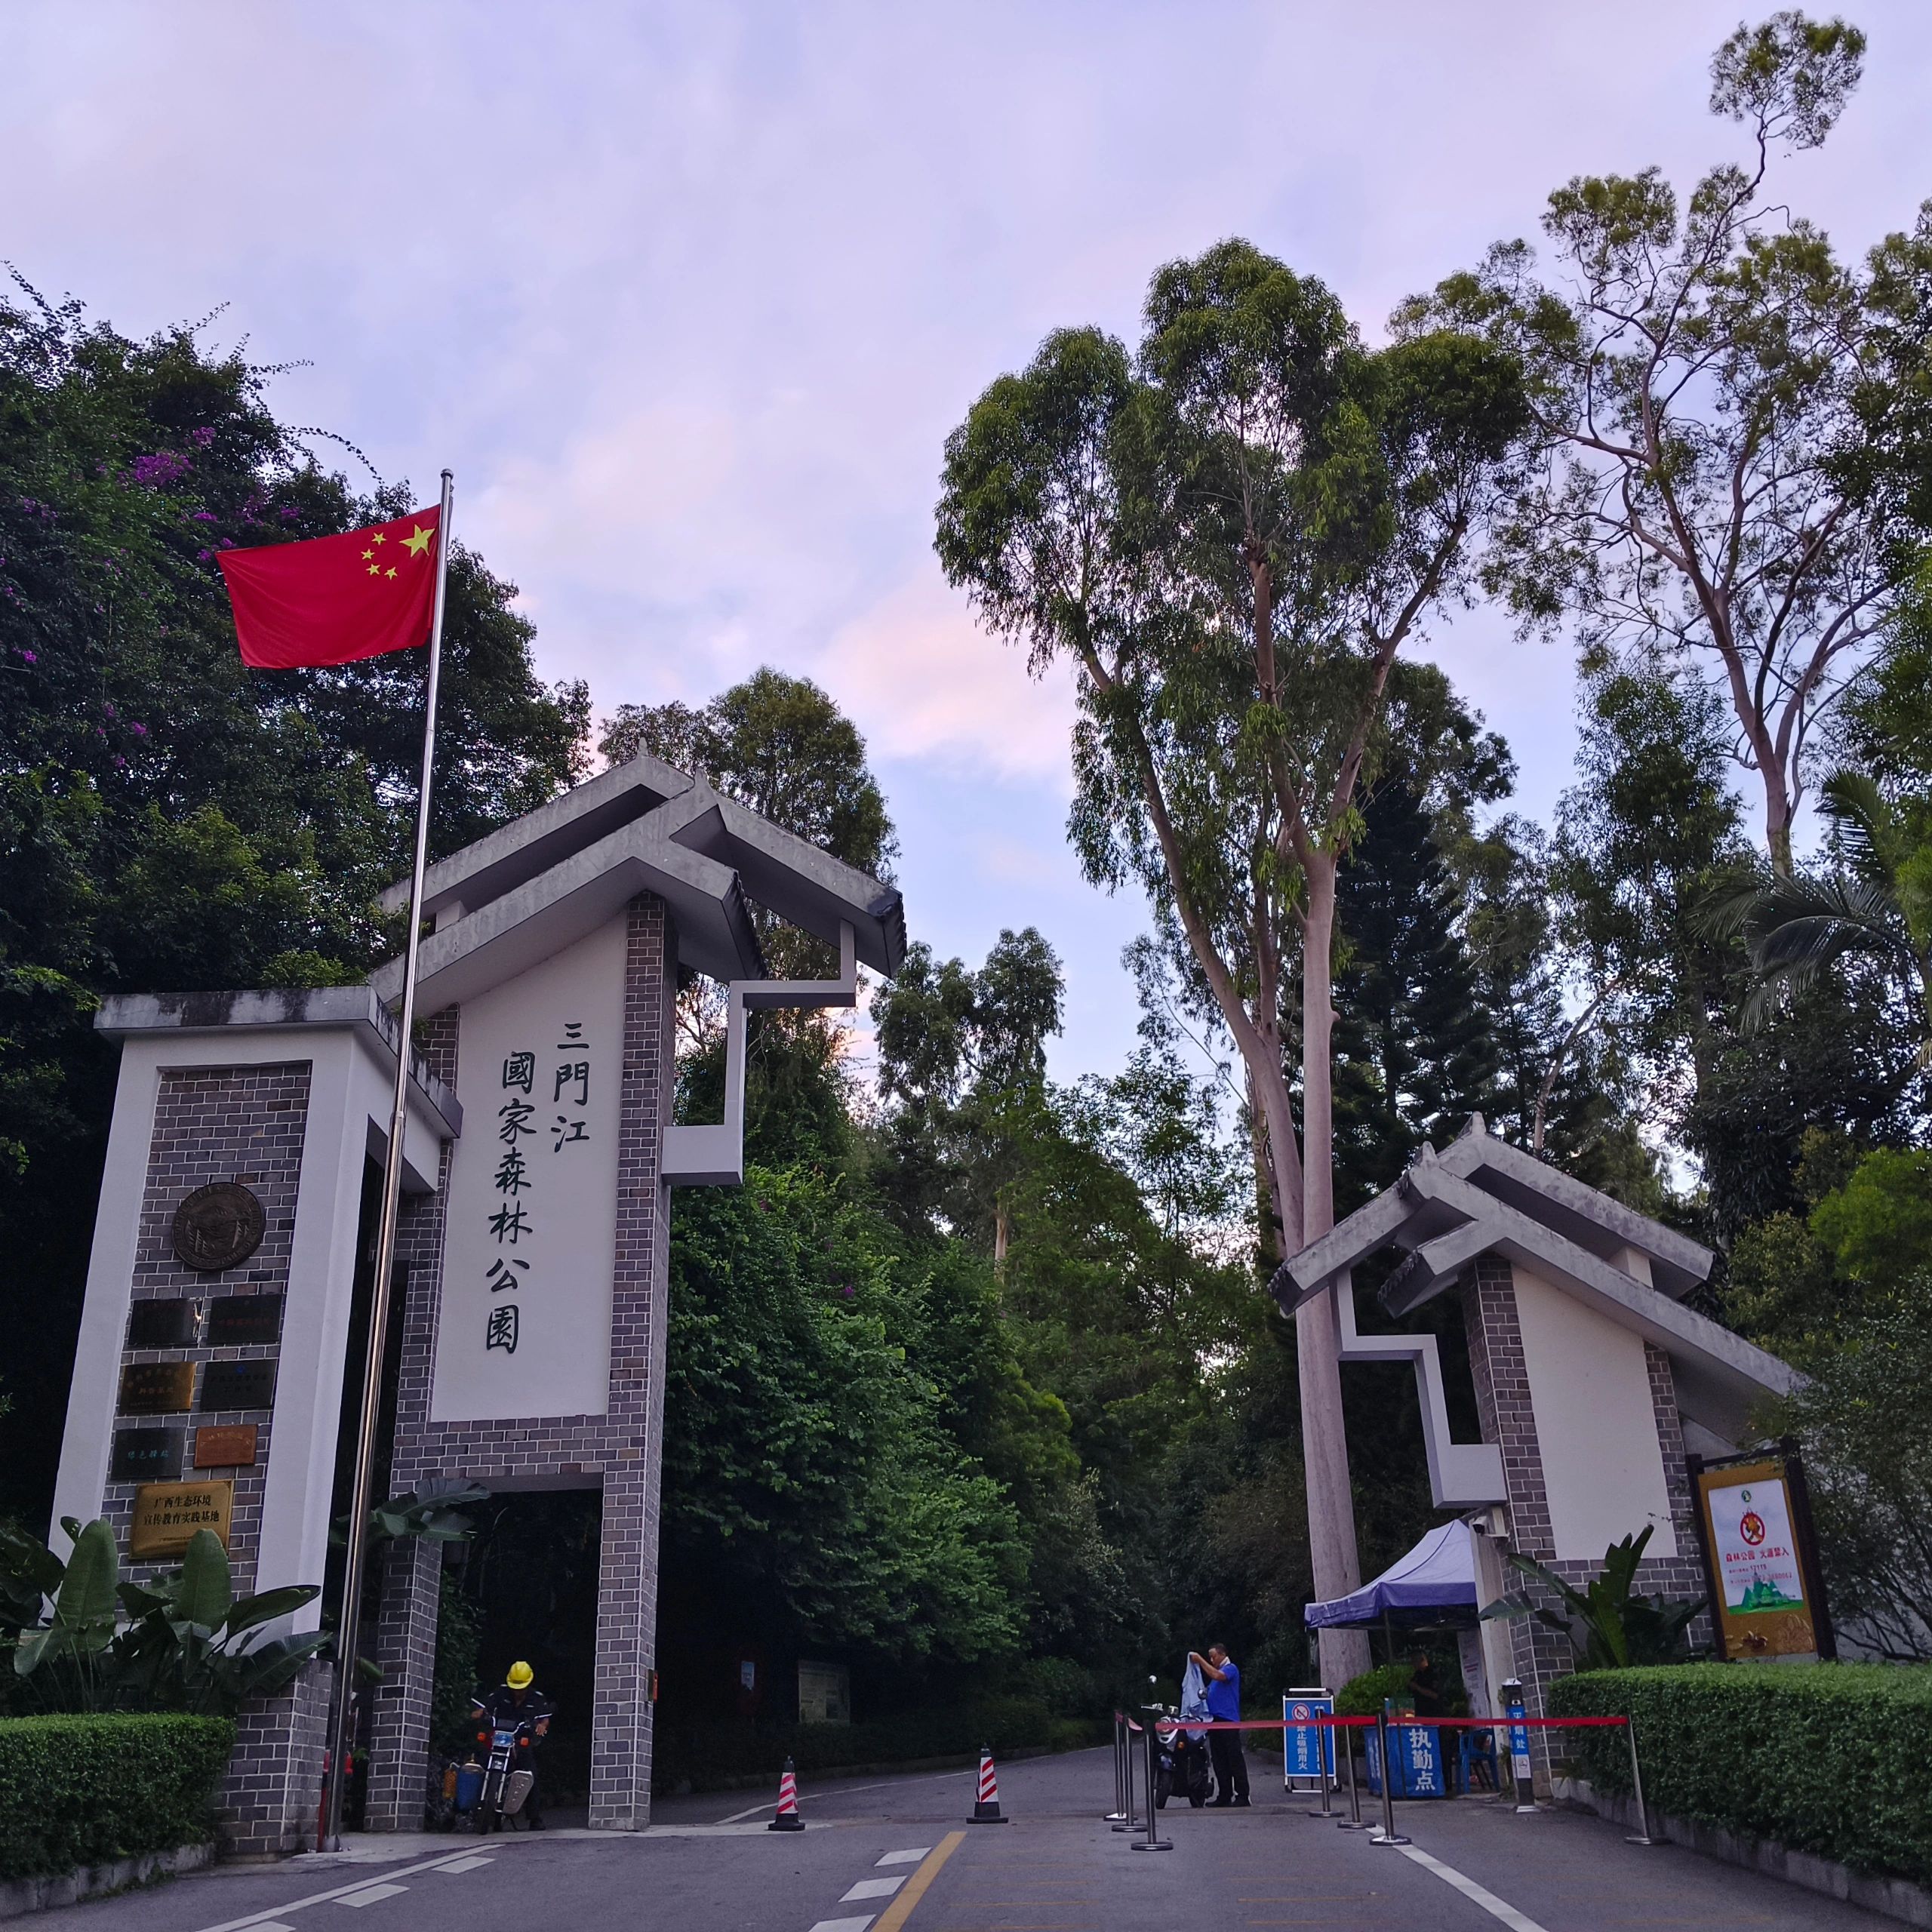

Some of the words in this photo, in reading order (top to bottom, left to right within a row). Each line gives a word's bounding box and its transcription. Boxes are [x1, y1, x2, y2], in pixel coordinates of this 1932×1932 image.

[551, 1022, 590, 1153] 三門江
[486, 1051, 537, 1355] 國家森林公園
[143, 1509, 220, 1526] 宣传教育实践基地
[153, 1494, 211, 1509] 广西生态环境
[1409, 1728, 1435, 1791] 执勤点
